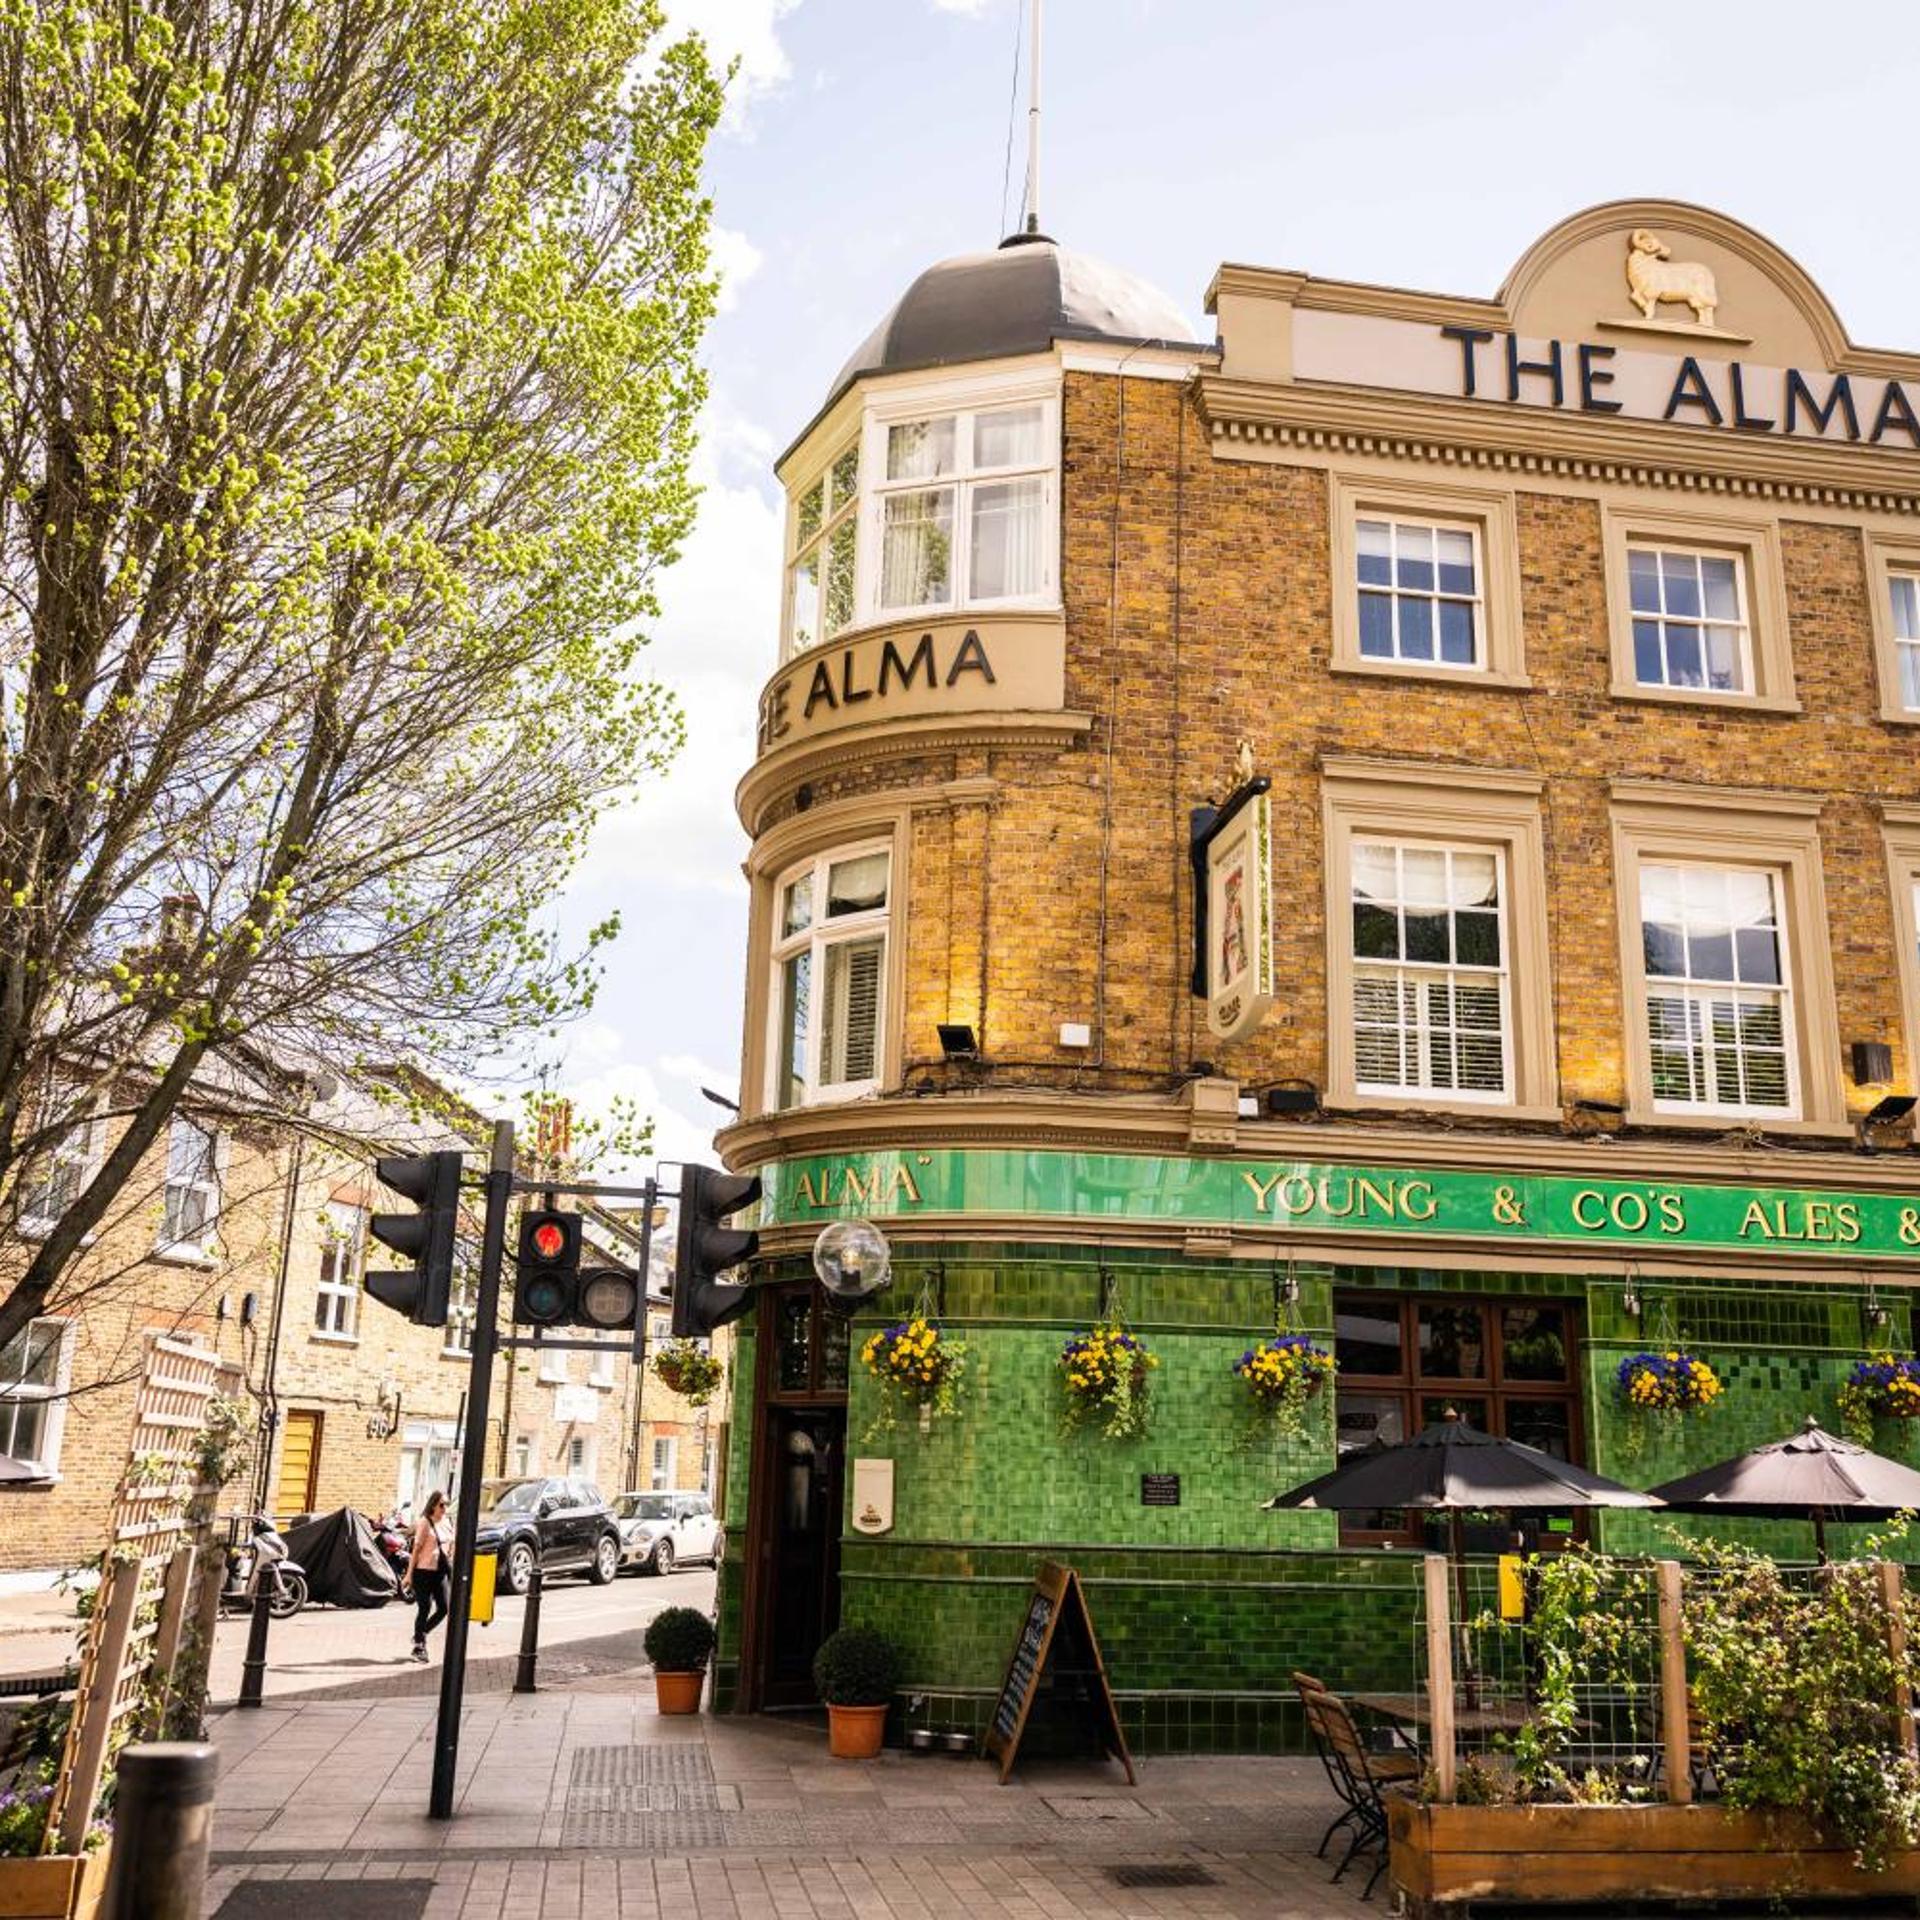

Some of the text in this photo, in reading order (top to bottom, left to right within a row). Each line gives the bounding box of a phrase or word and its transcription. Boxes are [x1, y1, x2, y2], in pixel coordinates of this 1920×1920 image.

[1440, 326, 1920, 448] THE ALMA
[757, 629, 996, 757] HE ALMA
[1242, 1171, 1438, 1221] YOUNG
[1493, 1184, 1529, 1226] &
[1571, 1189, 1687, 1234] CO'S
[1738, 1198, 1862, 1242] ALES
